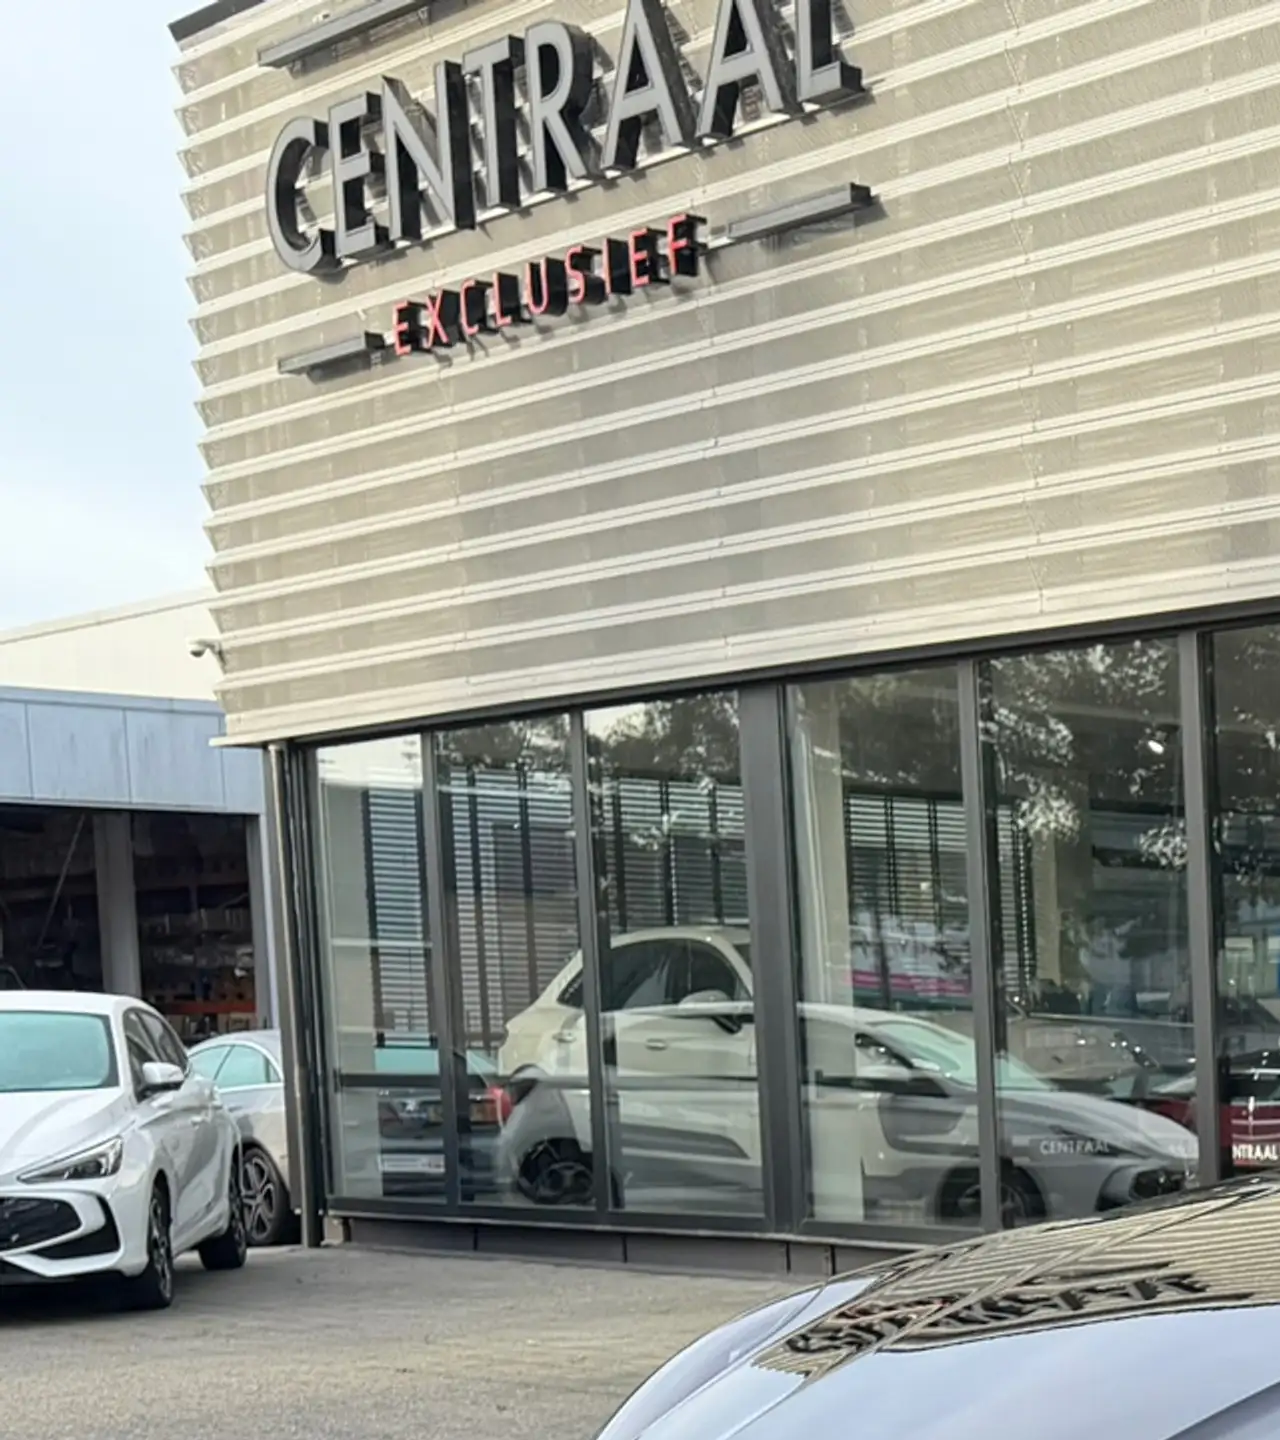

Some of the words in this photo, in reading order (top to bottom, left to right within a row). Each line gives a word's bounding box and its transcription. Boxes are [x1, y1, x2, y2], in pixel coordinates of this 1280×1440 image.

[265, 0, 866, 276] CENTRAAL
[391, 213, 702, 356] EXCLUSIEF
[1232, 1143, 1279, 1161] NTRAAL
